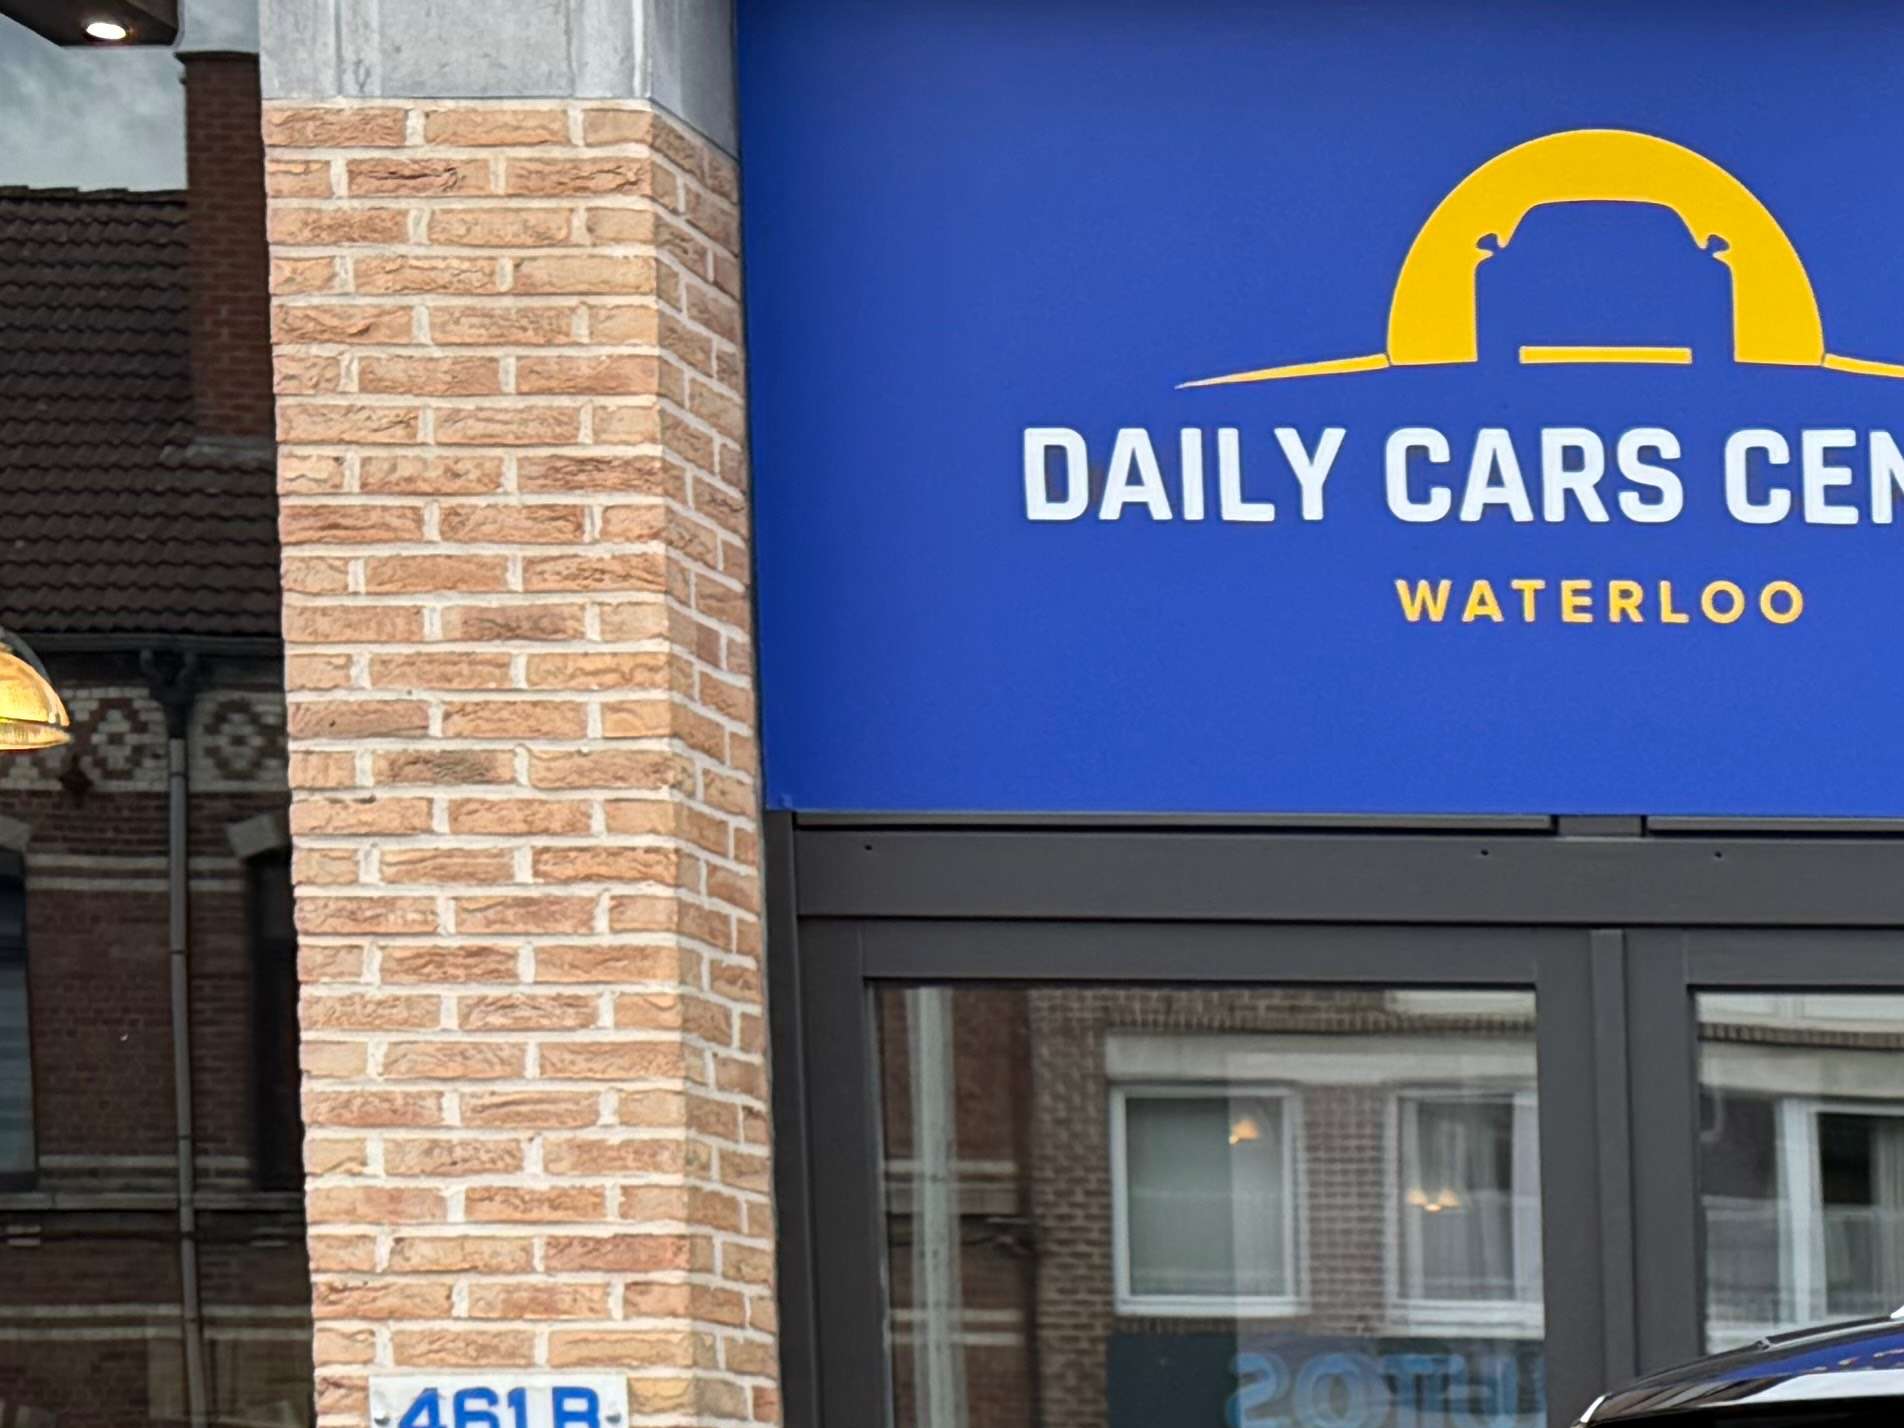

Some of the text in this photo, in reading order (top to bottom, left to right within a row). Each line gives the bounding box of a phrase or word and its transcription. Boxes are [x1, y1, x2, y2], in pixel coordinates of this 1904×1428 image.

[1023, 426, 1346, 522] DAILY
[1384, 426, 1685, 524] CARS
[1395, 578, 1805, 625] WATERLOO
